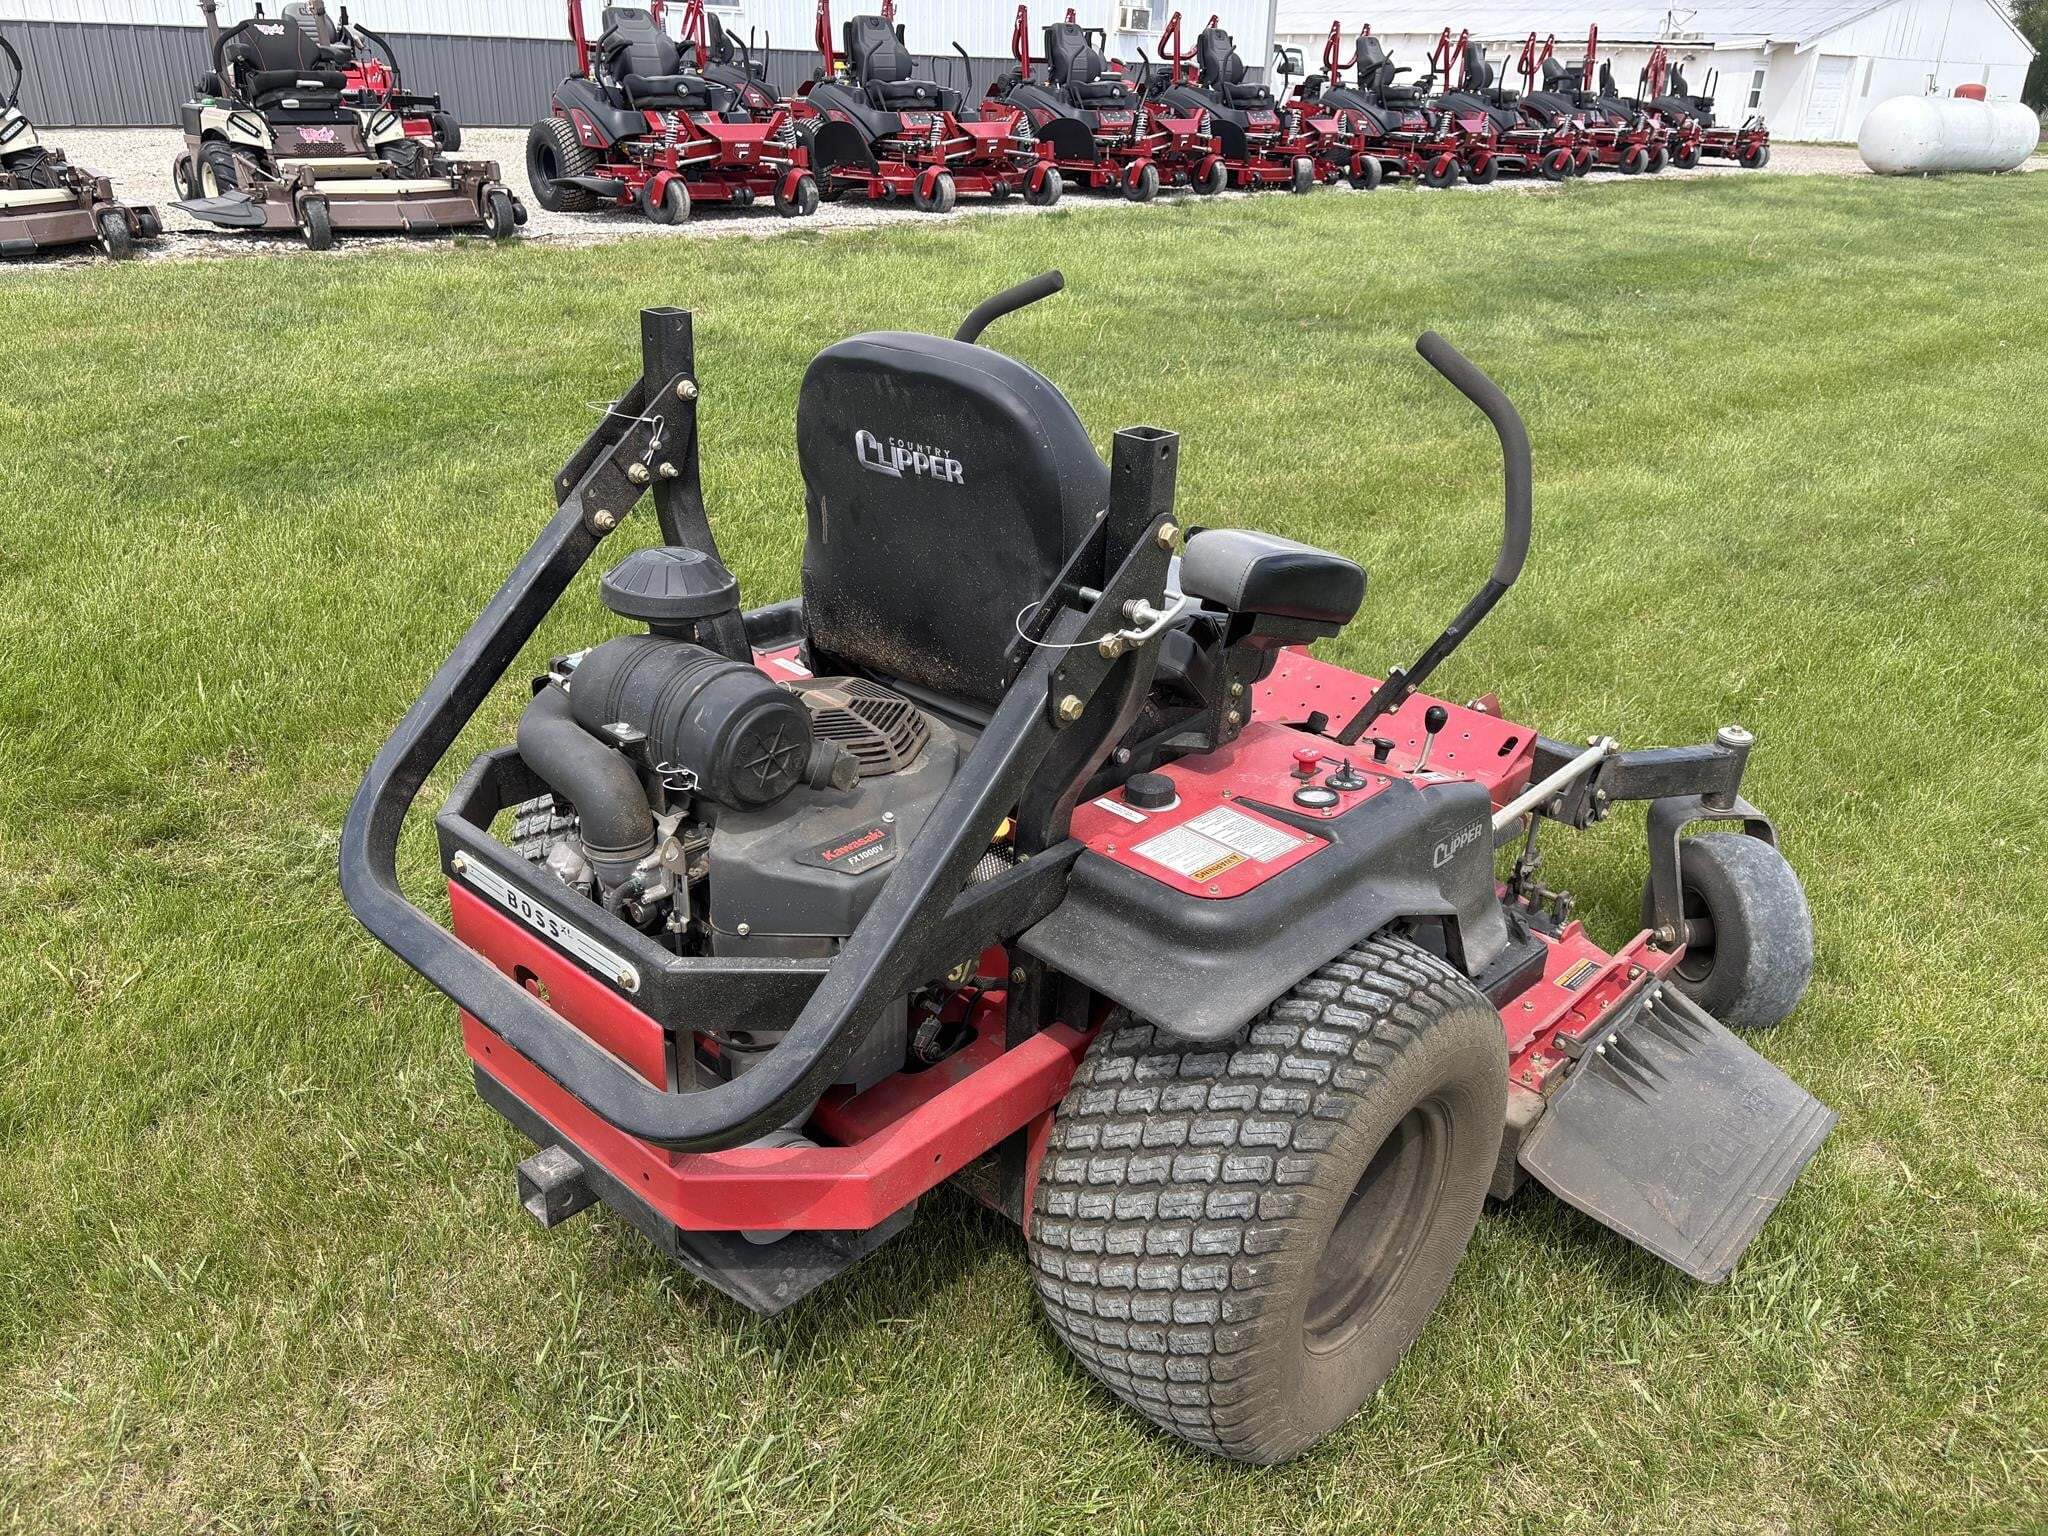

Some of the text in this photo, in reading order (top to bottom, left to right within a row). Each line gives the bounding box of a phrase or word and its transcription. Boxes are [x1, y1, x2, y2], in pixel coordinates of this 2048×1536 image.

[855, 429, 965, 485] CLIPPER
[888, 437, 951, 458] COUNTRY
[822, 828, 886, 862] Kawasaki
[847, 844, 884, 866] FX1000V
[1433, 824, 1482, 869] CLIPPER
[1194, 858, 1234, 880] WARNING
[507, 890, 560, 938] BOSS
